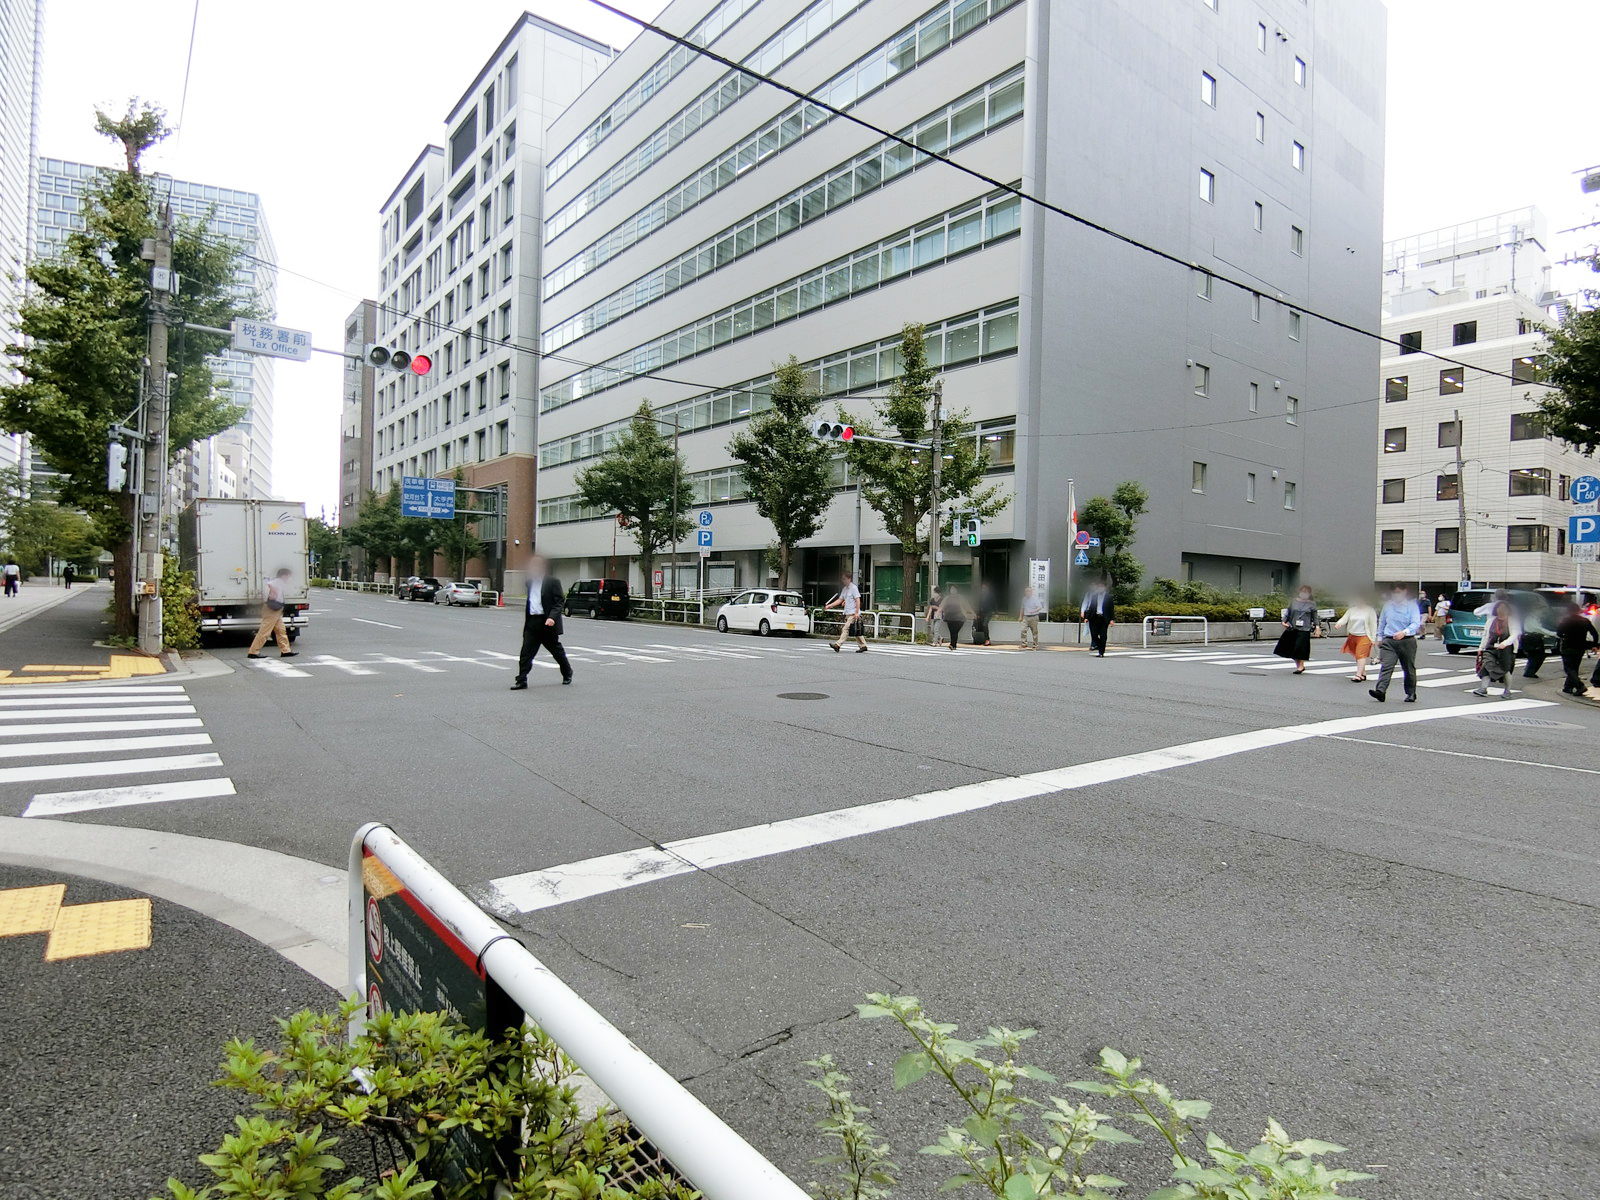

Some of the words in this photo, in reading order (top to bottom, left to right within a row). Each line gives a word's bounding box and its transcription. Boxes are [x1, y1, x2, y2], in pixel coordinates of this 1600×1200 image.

[243, 323, 306, 346] 税務署前
[251, 338, 267, 349] Tax
[271, 342, 298, 355] Office
[701, 532, 711, 545] P
[1576, 518, 1596, 541] P
